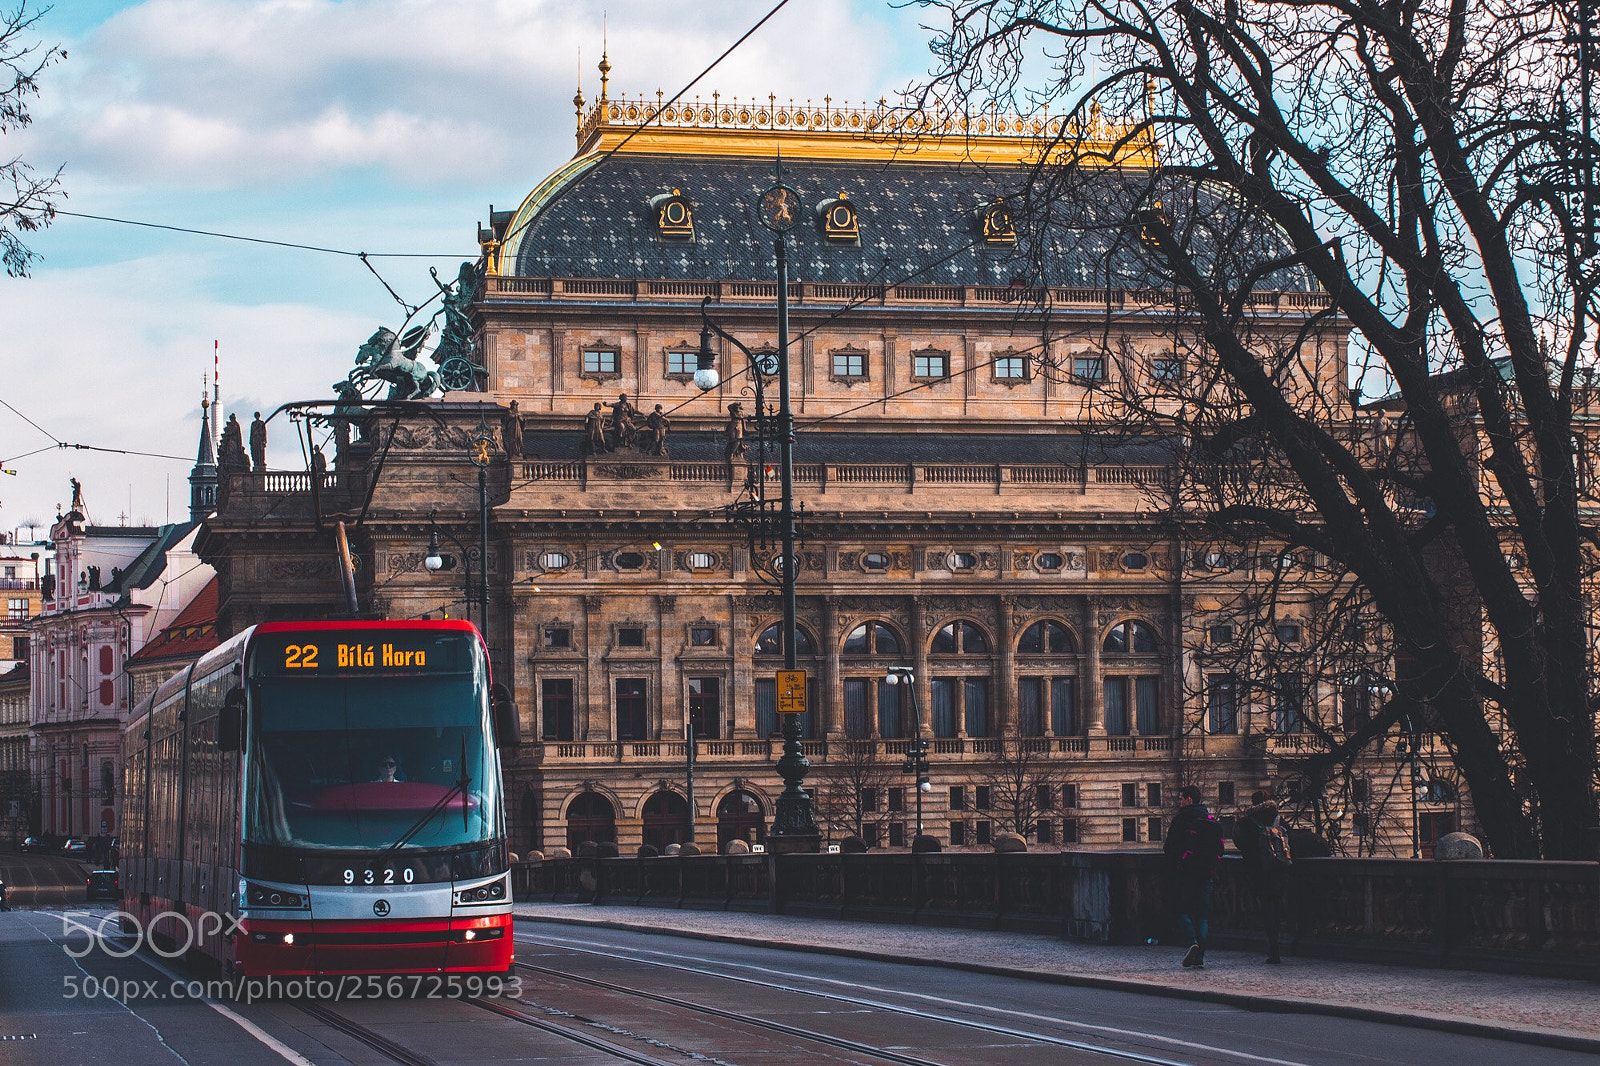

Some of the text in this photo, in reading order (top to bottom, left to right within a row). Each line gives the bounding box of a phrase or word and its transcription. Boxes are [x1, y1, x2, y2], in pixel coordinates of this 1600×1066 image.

[285, 643, 426, 668] 22 Bílá Hora
[343, 867, 414, 884] 9320
